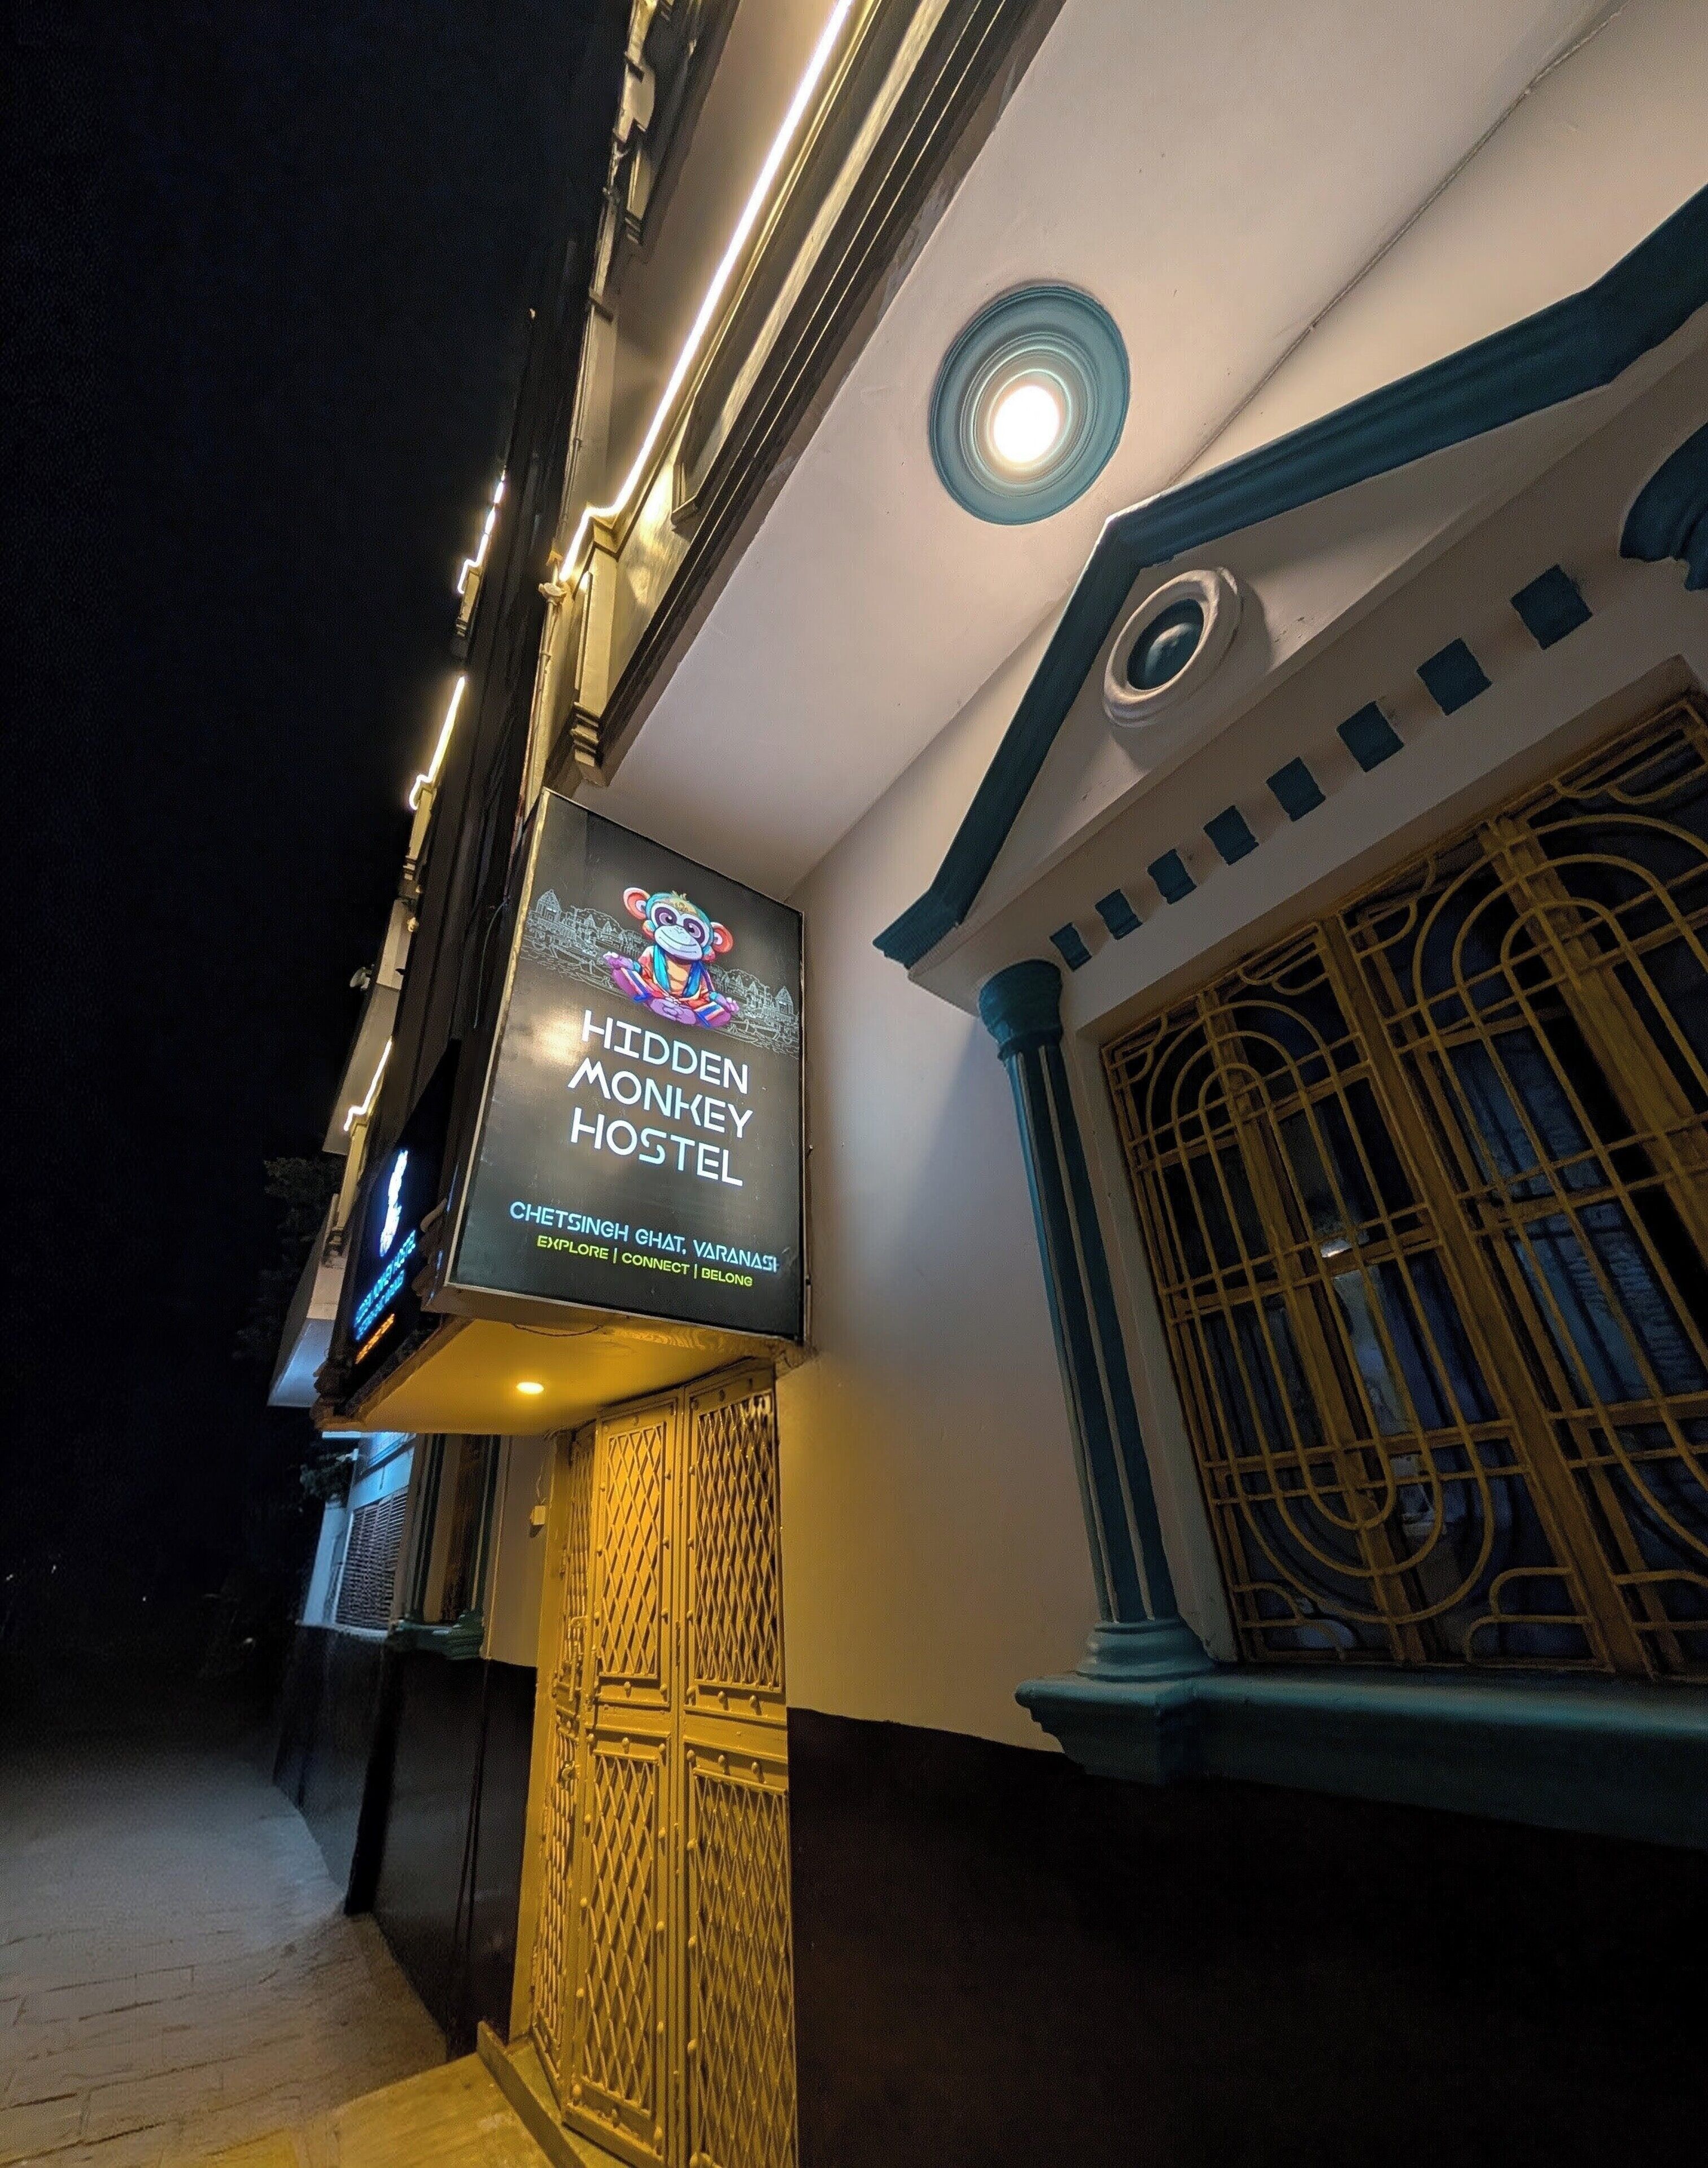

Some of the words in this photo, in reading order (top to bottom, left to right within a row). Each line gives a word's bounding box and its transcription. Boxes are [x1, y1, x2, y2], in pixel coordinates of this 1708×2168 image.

[582, 1009, 748, 1094] HIDDEN
[567, 1057, 753, 1138] MONKEY
[570, 1107, 743, 1186] HOSTEL
[509, 1201, 629, 1242] CHETSINGH
[635, 1228, 687, 1255] GHAT,
[693, 1239, 779, 1273] VARANASI
[537, 1235, 609, 1260] EXPLORE
[621, 1252, 690, 1275] CONNECT
[701, 1268, 753, 1287] BELONG
